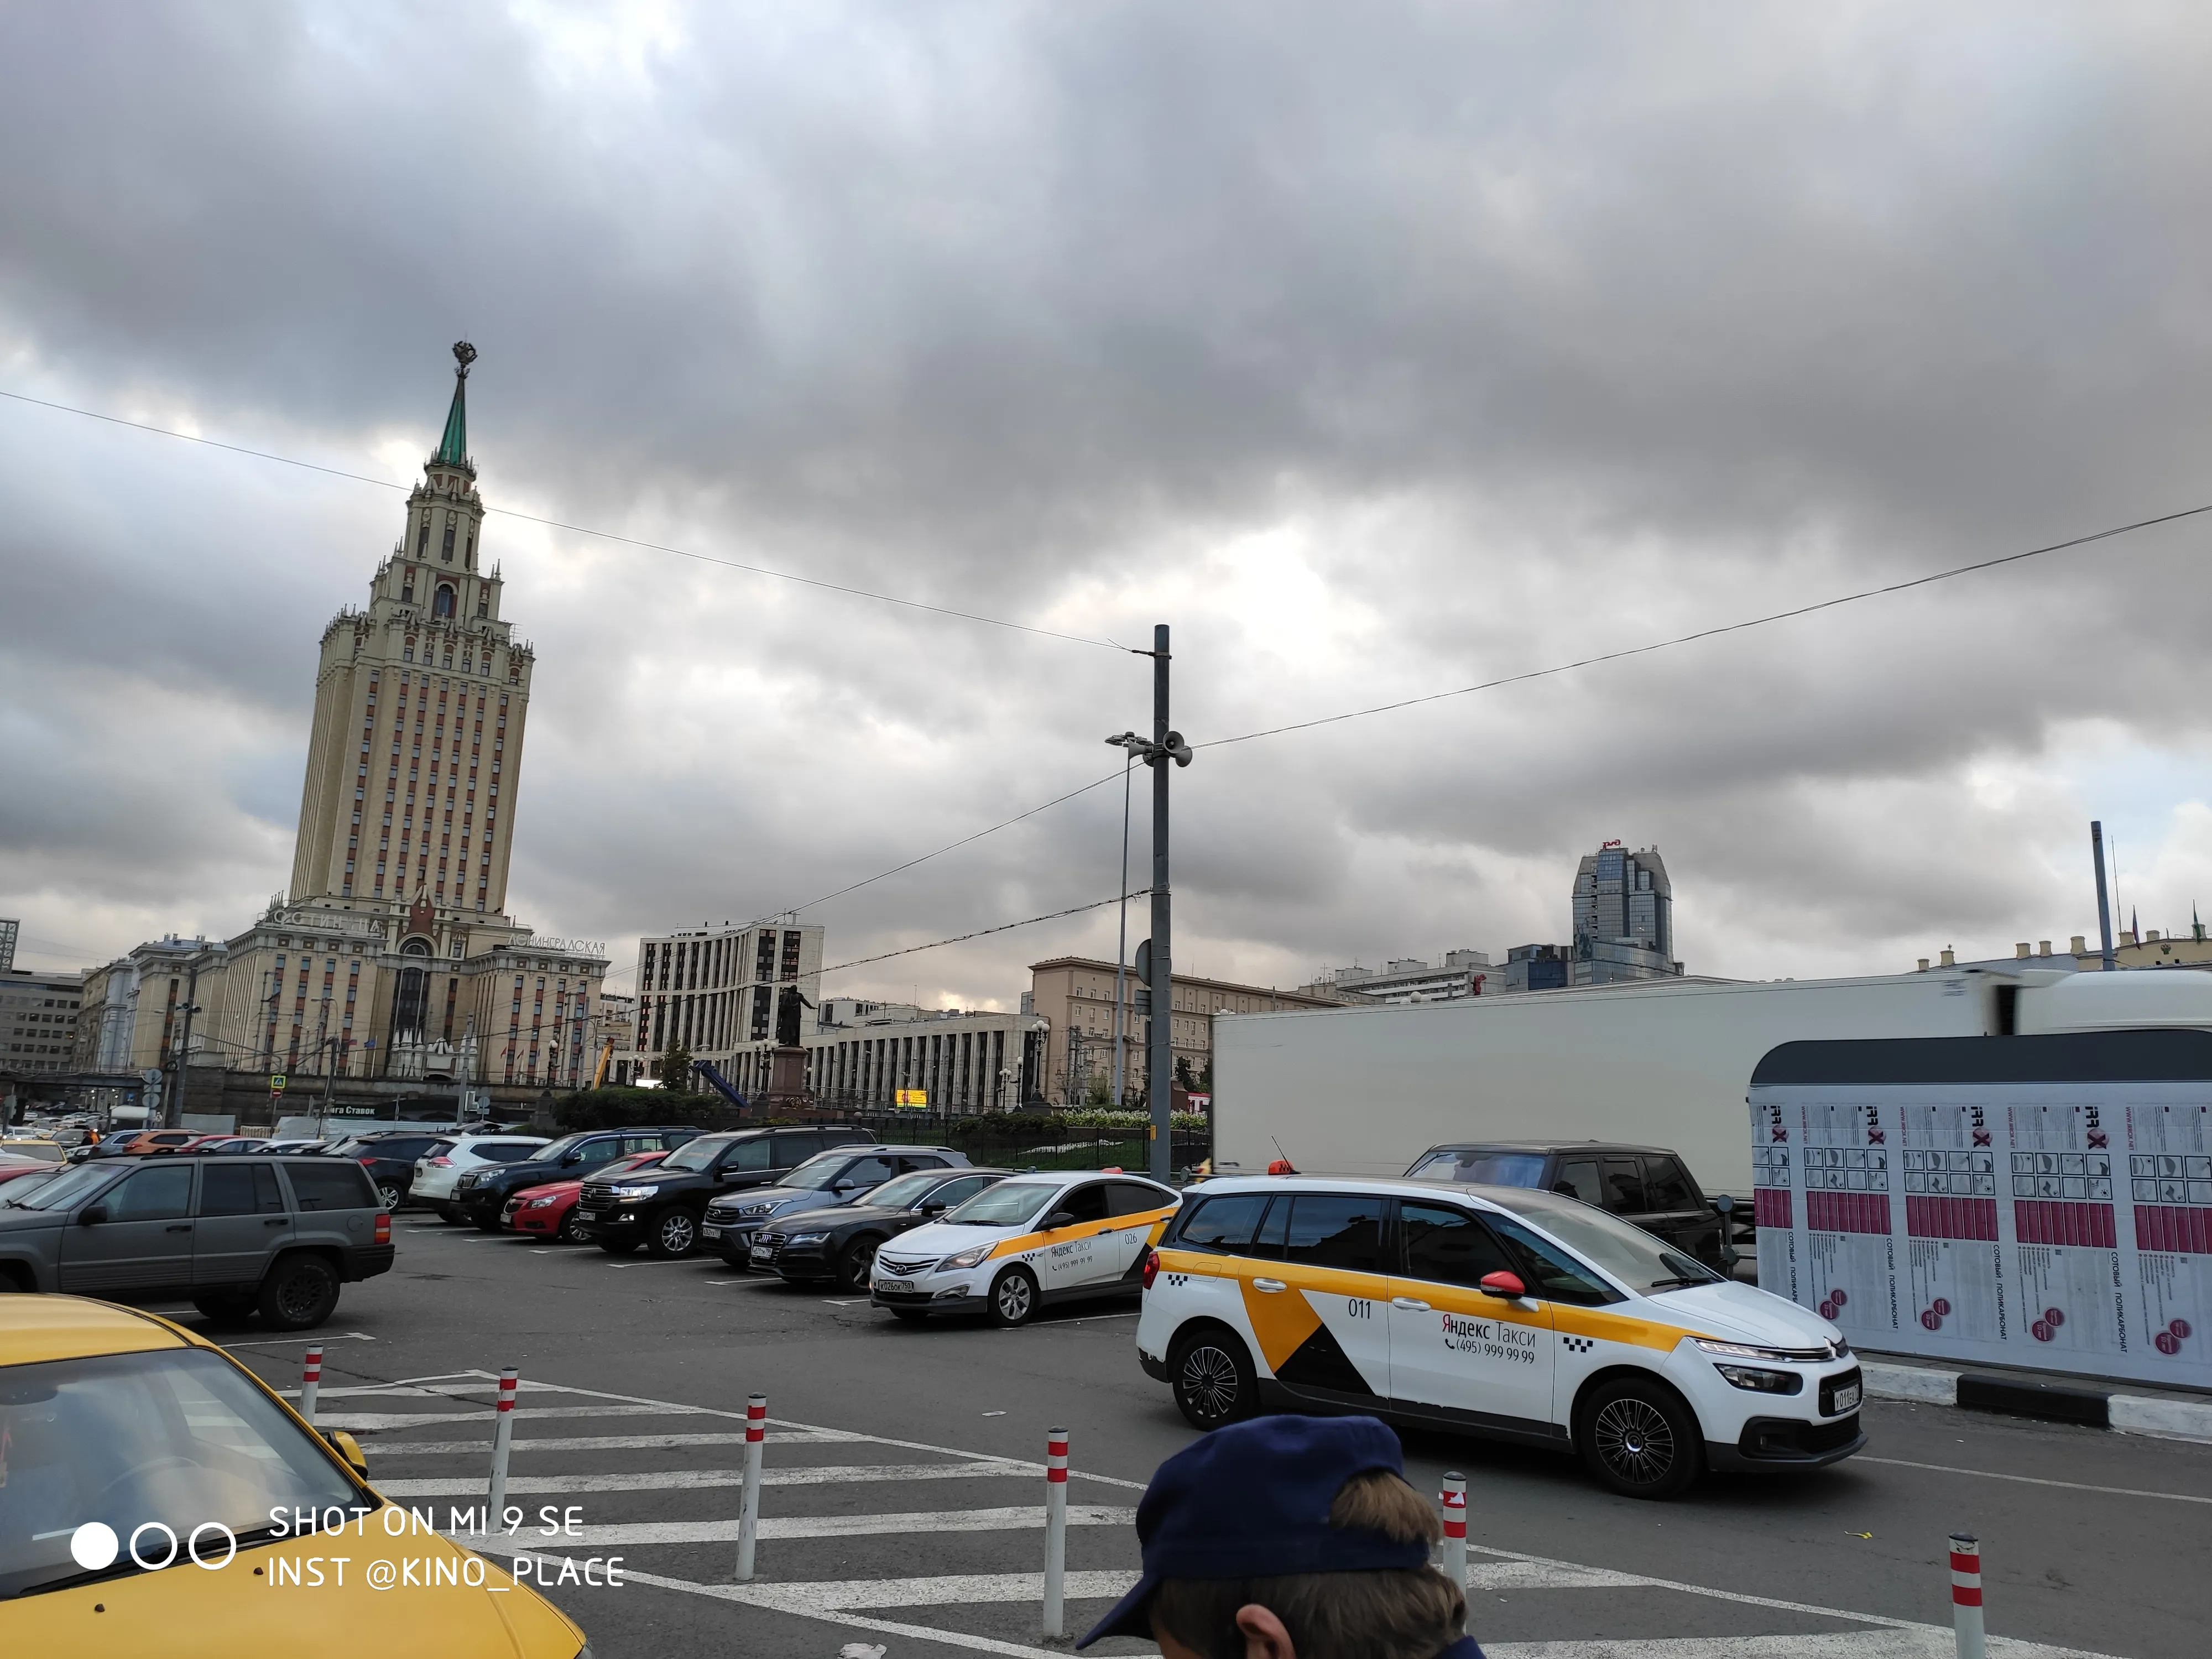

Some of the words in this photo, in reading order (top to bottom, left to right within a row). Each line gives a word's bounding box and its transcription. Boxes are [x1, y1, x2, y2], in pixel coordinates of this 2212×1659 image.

[346, 1106, 375, 1115] Ставок
[1051, 1245, 1073, 1258] Яндекс
[1074, 1240, 1092, 1253] Такси
[1125, 1233, 1138, 1245] 026
[1788, 1232, 1796, 1263] СОТОВЫЙ
[1886, 1238, 1895, 1270] СОТОВЫЙ
[1058, 1261, 1070, 1271] (495)
[1994, 1245, 2003, 1278] СОТОВЫЙ
[2111, 1252, 2122, 1287] СОТОВЫЙ
[881, 1282, 901, 1291] К026ОК
[1889, 1275, 1898, 1329] ПОЛИКАРБОНАТ
[1349, 1298, 1370, 1319] 011
[1997, 1283, 2007, 1340] ПОЛИКАРБОНАТ
[2115, 1292, 2127, 1353] ПОЛИКАРБОНАТ
[1442, 1314, 1490, 1339] Яндекс
[1495, 1321, 1536, 1348] Такси
[1457, 1339, 1481, 1354] (495)
[1484, 1344, 1503, 1358] 999
[1507, 1348, 1519, 1361] 99
[1522, 1350, 1535, 1364] 99
